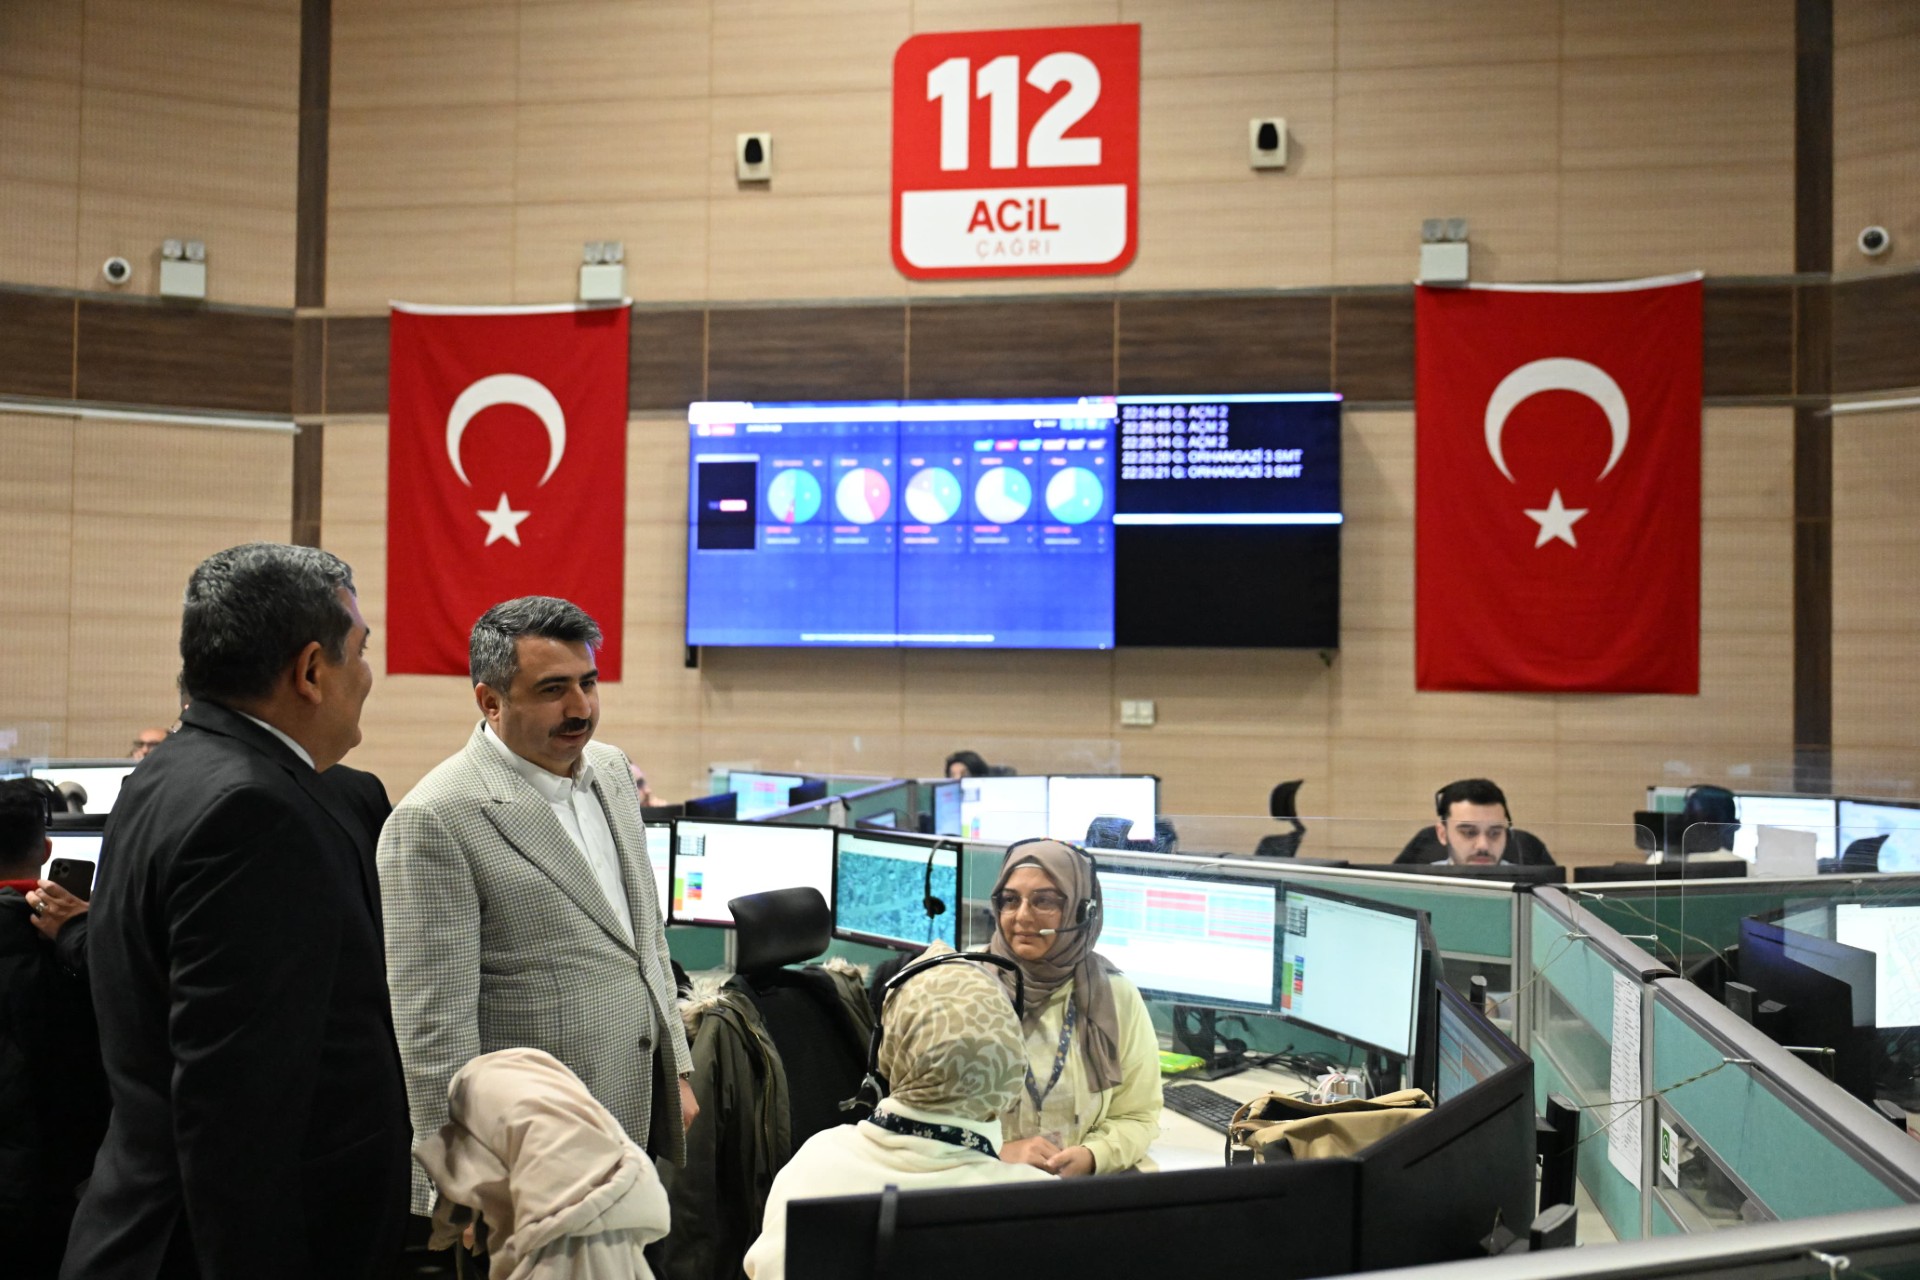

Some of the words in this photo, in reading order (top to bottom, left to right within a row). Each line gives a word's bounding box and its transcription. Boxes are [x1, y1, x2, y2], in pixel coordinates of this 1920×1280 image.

[926, 51, 1102, 172] 112
[975, 237, 1052, 261] ÇAĞRI
[1218, 404, 1229, 418] 2
[1218, 419, 1229, 433] 2
[1218, 434, 1229, 448] 2
